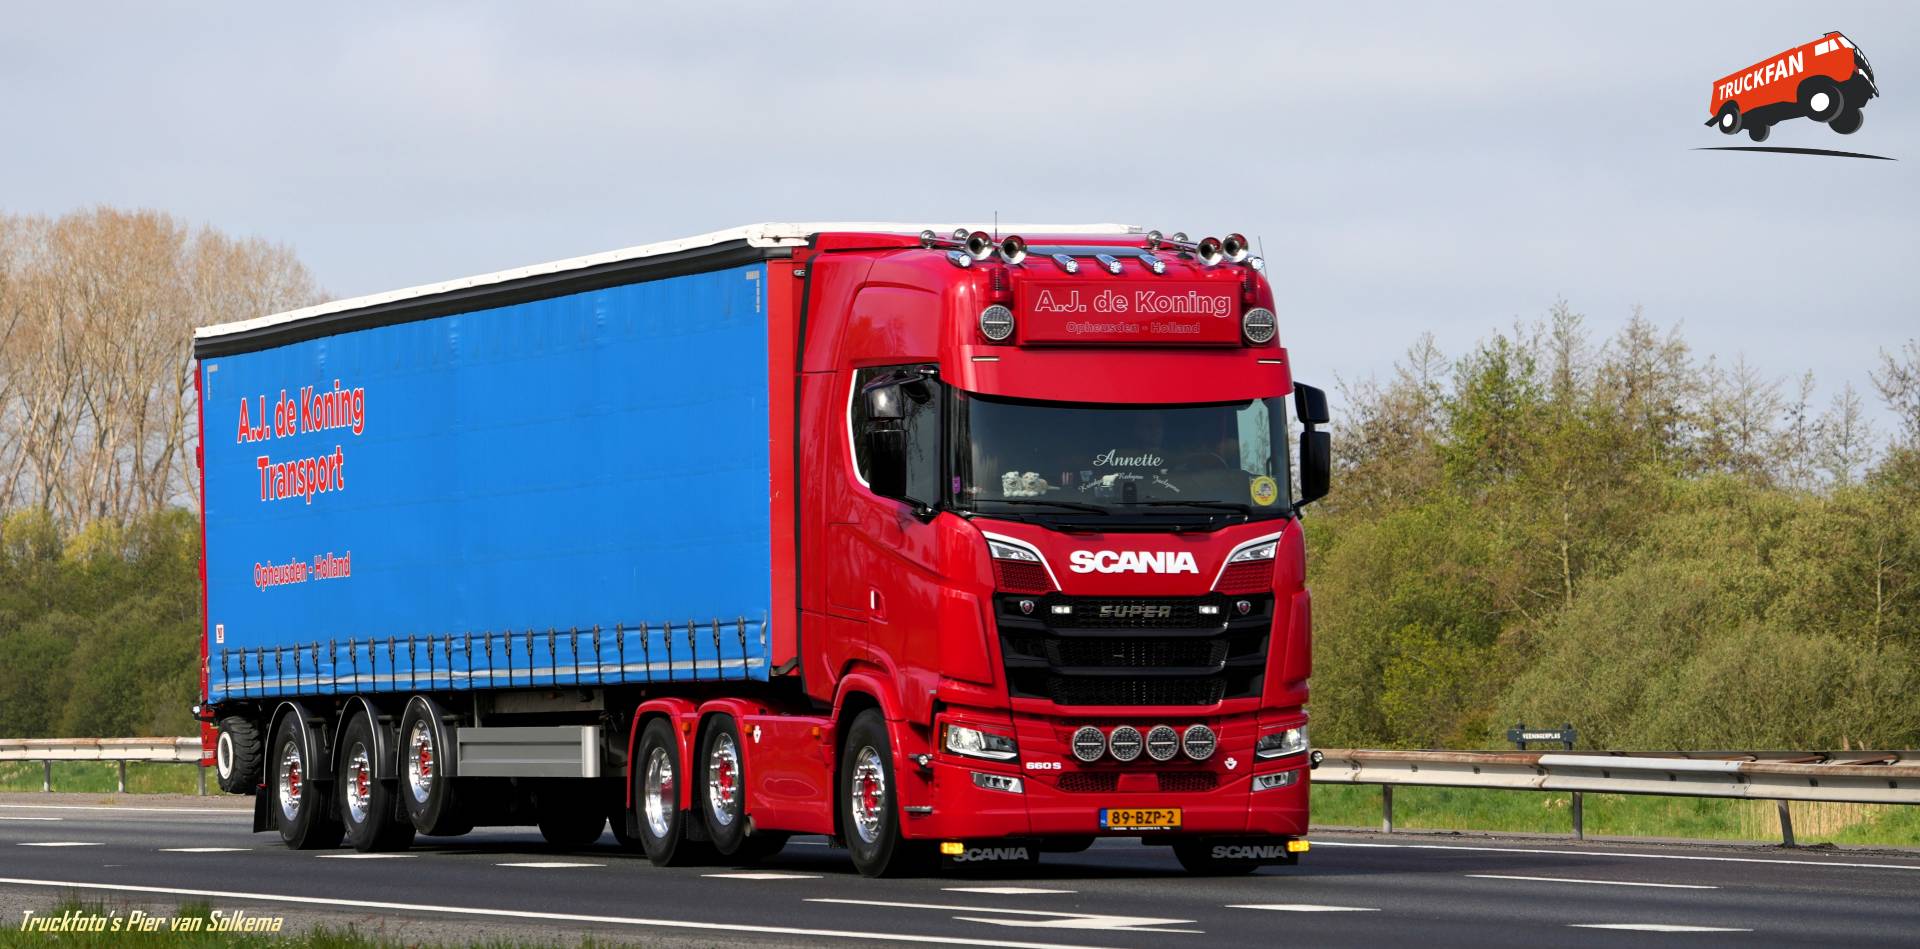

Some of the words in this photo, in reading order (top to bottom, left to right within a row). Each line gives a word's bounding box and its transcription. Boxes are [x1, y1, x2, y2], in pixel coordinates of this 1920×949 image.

[1035, 290, 1087, 312] A.J.
[1093, 290, 1128, 313] de
[1135, 290, 1231, 318] Koning
[1065, 321, 1140, 336] Opheusden
[1150, 321, 1201, 334] Holland
[236, 396, 271, 444] A.J.
[275, 389, 297, 439] de
[300, 379, 366, 436] Koning
[1093, 449, 1164, 467] Annette
[257, 445, 344, 505] Transport
[254, 558, 307, 592] Opheusden
[314, 551, 351, 581] Holland
[1069, 550, 1199, 575] SCANIA
[1099, 605, 1171, 618] SUPER
[1026, 762, 1052, 770] 660
[1052, 762, 1062, 770] S
[1112, 811, 1175, 824] 89-BZP-2
[1211, 845, 1288, 859] SCANIA
